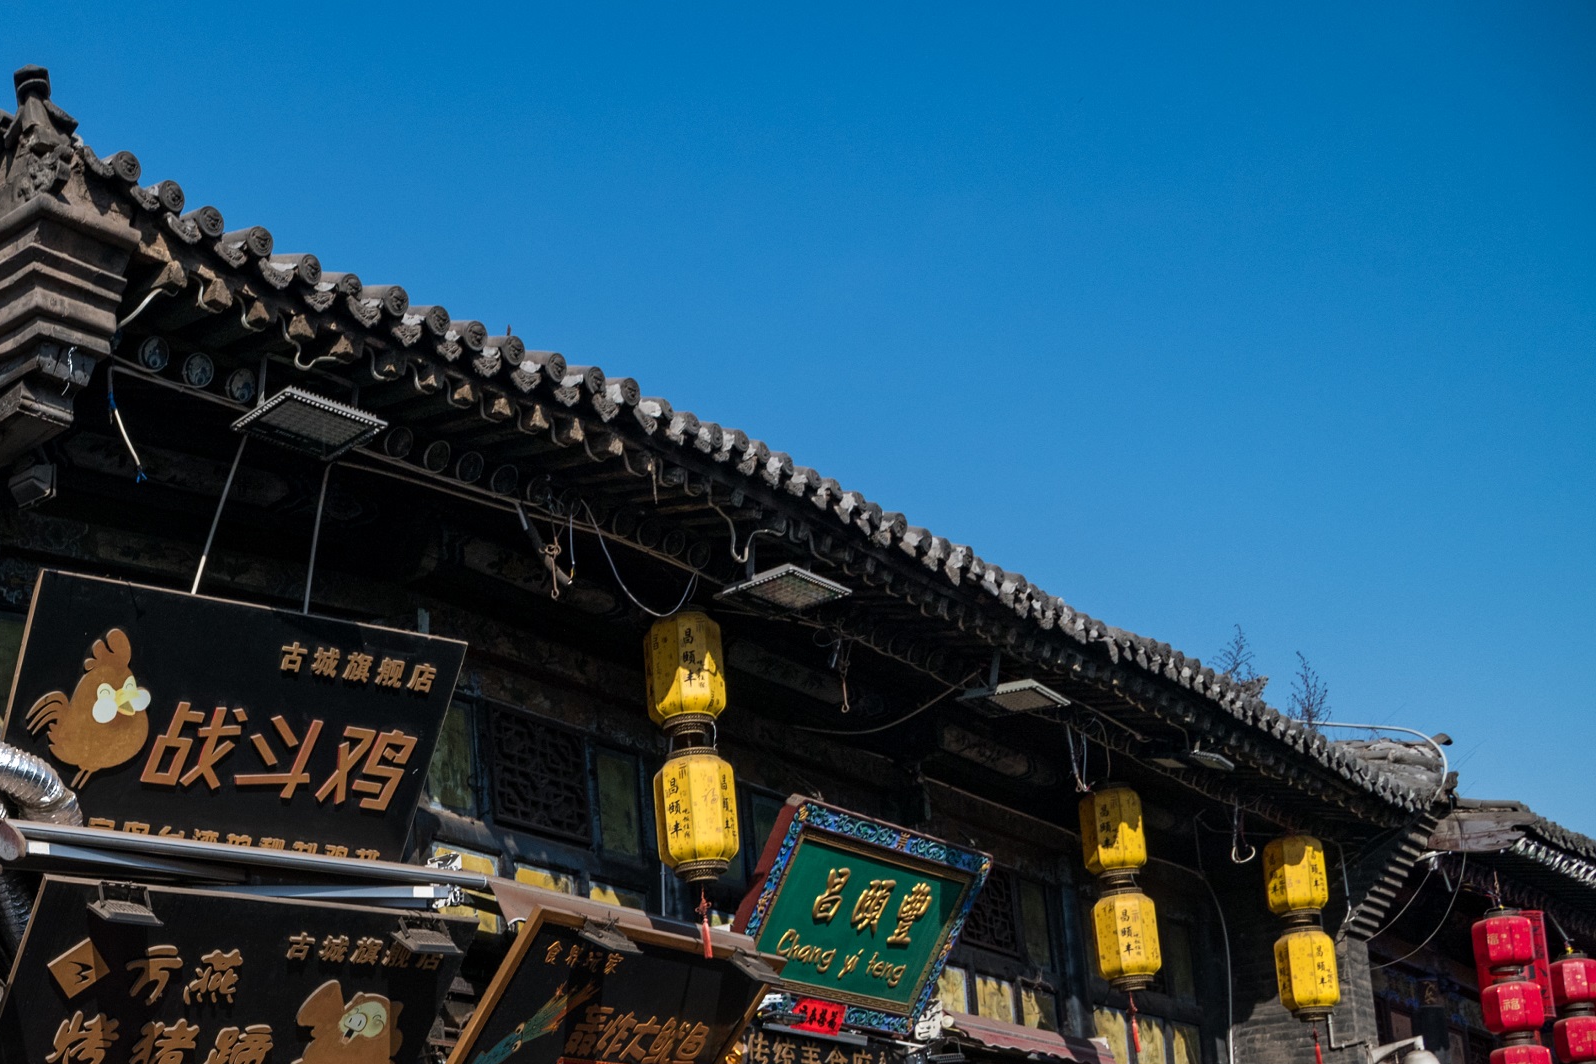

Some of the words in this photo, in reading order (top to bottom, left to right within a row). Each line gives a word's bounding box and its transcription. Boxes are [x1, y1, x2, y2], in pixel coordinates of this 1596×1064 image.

[280, 642, 437, 694] 古城旗舰店
[140, 701, 417, 811] 战斗鸡
[126, 944, 245, 1006] 方燕
[286, 932, 443, 970] 古城旗舰店
[777, 929, 836, 973] Chang
[1501, 997, 1521, 1011] 福
